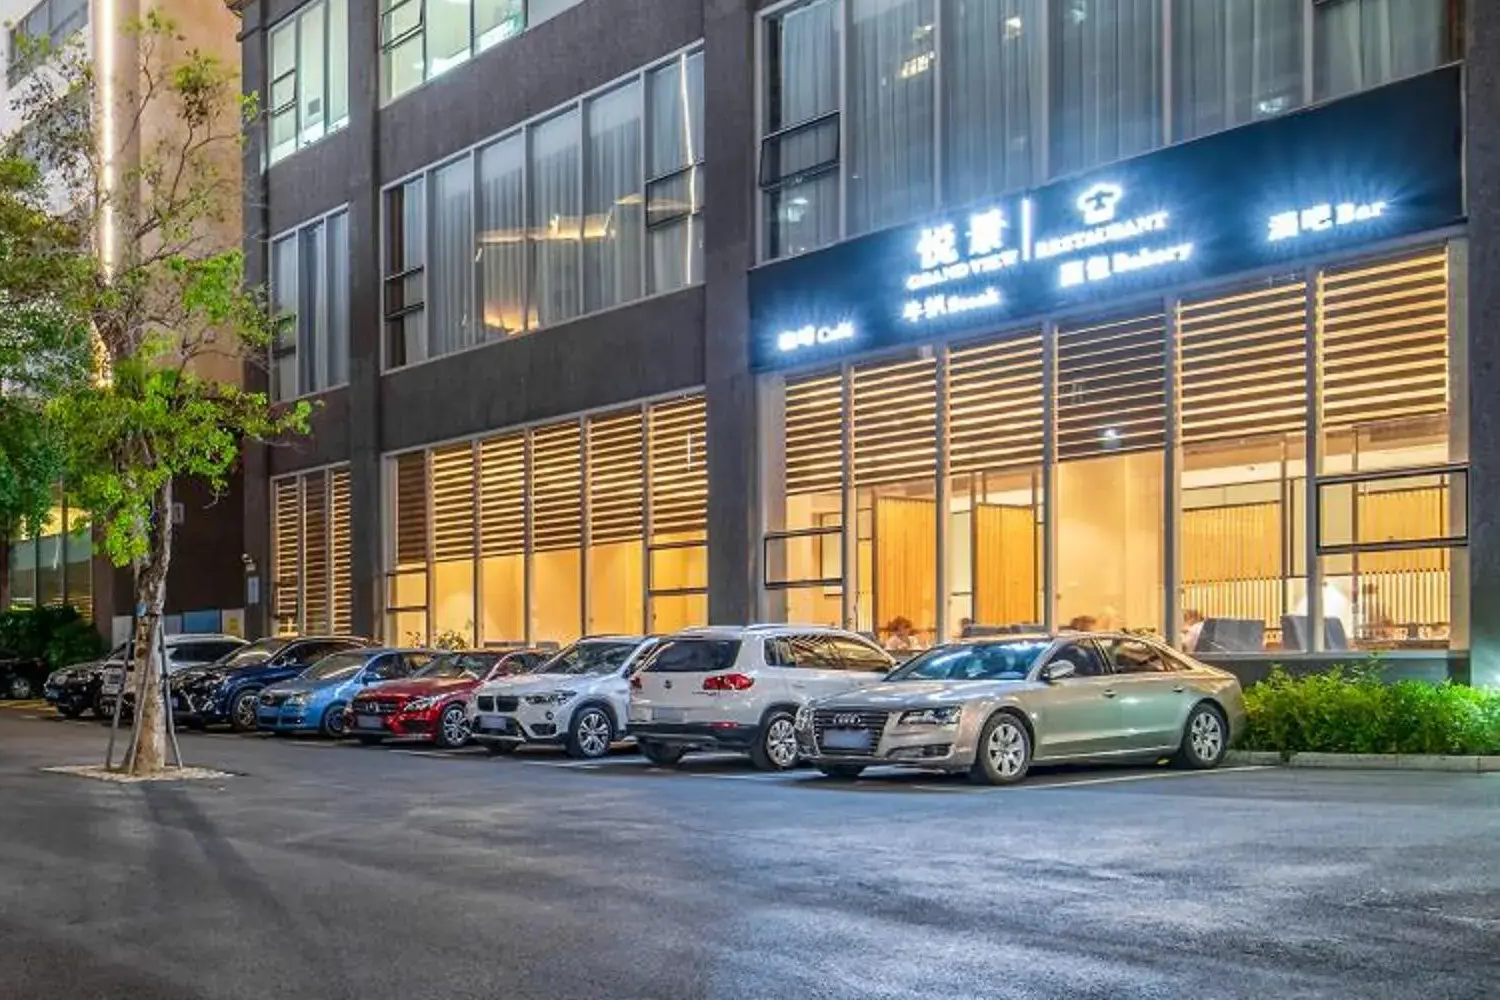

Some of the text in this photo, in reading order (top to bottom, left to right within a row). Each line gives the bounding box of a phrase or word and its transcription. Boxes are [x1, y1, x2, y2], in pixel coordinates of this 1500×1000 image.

[1335, 201, 1386, 225] Bar
[1035, 211, 1169, 259] RESTAURANT
[905, 249, 1019, 291] GRAND VIEW
[1112, 242, 1194, 273] Bakery
